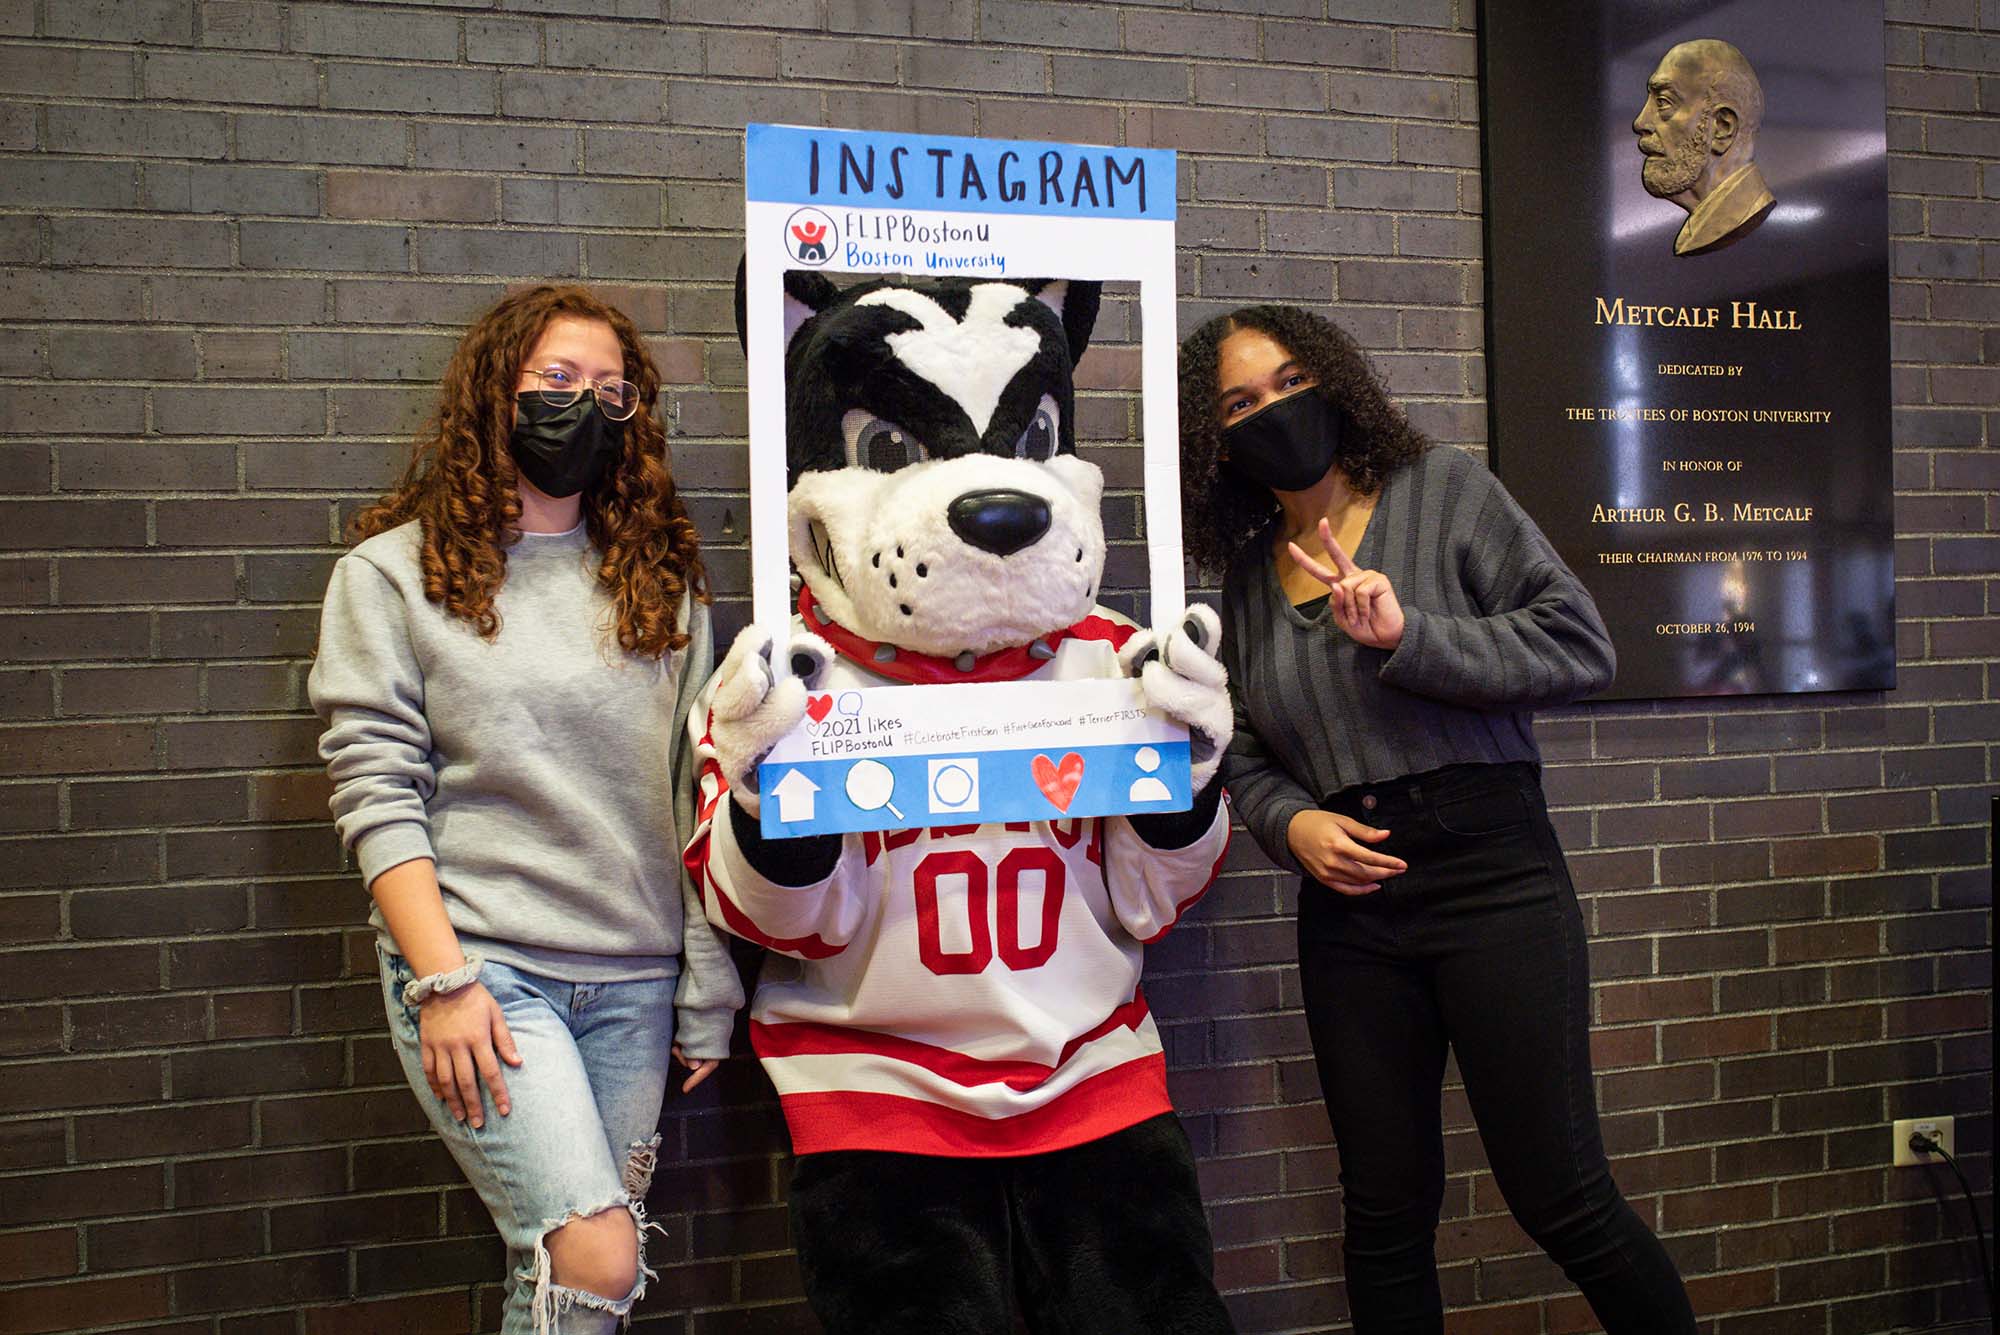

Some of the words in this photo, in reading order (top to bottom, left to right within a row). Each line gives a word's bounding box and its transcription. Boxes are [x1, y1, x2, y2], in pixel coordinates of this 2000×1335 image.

[846, 213, 990, 244] FLIPBostonU
[846, 242, 913, 267] Boston
[926, 252, 1006, 274] University
[1658, 364, 1725, 376] DEDICATED
[1728, 365, 1743, 377] BY
[1566, 407, 1595, 421] THE
[1598, 408, 1666, 421] TRTEES
[1670, 409, 1689, 422] OF
[1692, 409, 1749, 423] BOSTON
[1753, 411, 1832, 424] UNIVERSITY
[1663, 461, 1676, 471] IN
[1680, 461, 1724, 471] HONOR
[1728, 461, 1743, 471] OF
[1674, 503, 1696, 522] G.
[1704, 503, 1724, 522] B.
[1598, 553, 1634, 564] THEIR
[1637, 552, 1702, 563] CHAIRMAN
[1705, 552, 1738, 563] FROM
[1742, 551, 1763, 562] 1976
[1766, 551, 1783, 561] TO
[1785, 551, 1808, 561] 1994
[1656, 624, 1712, 635] OCTOBER
[1715, 623, 1730, 635] 26,
[1733, 622, 1755, 633] 1994
[868, 717, 903, 734] likes
[811, 735, 893, 756] FLIPBostonU
[913, 847, 1065, 976] 00
